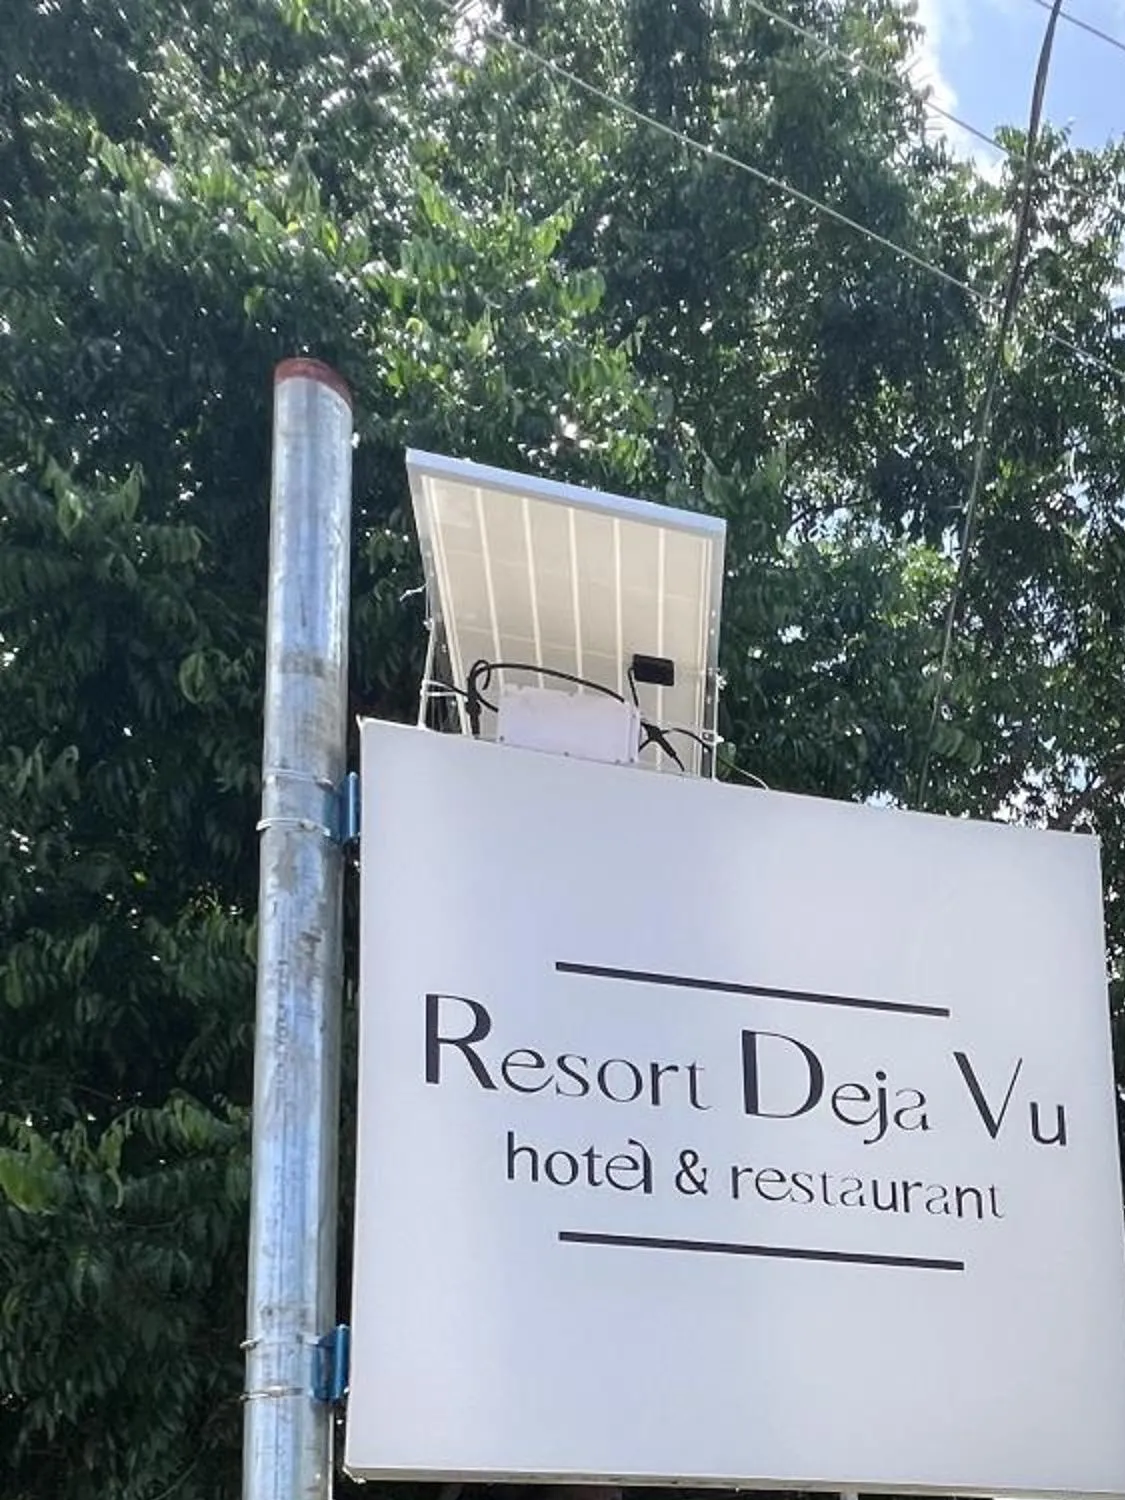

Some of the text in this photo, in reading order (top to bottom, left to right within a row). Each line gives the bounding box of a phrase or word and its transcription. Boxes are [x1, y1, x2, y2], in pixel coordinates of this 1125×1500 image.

[425, 993, 1068, 1147] Resort Deja Vu
[506, 1130, 1005, 1220] hotel & restaurant
